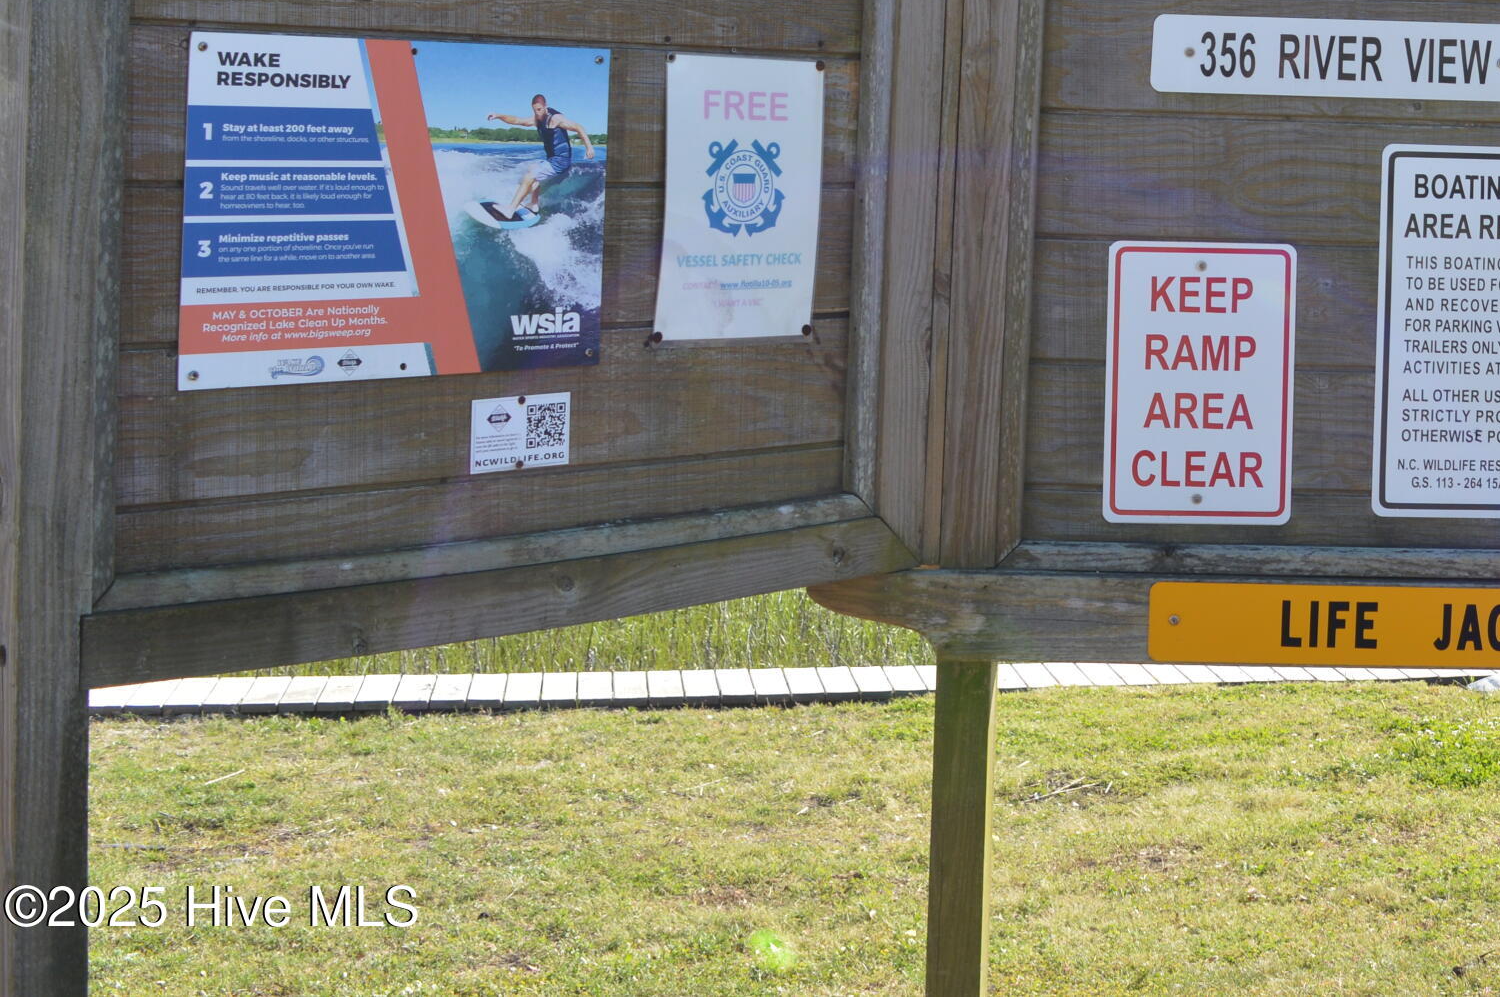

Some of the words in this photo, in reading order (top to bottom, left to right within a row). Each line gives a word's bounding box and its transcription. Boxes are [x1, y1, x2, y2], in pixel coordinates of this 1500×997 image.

[218, 52, 280, 67] WAKE
[1200, 32, 1255, 78] 356
[1279, 34, 1382, 81] RIVER
[1404, 38, 1492, 84] VIEW
[217, 71, 351, 89] RESPONSIBLY
[704, 90, 788, 121] FREE
[203, 123, 212, 140] 1
[223, 124, 246, 134] Stay
[247, 124, 258, 132] at
[259, 124, 284, 132] least
[307, 125, 326, 133] feet
[328, 127, 354, 135] away
[221, 173, 247, 182] Keep
[249, 172, 279, 180] music
[348, 172, 377, 180] levels.
[725, 155, 752, 170] COAST
[755, 159, 769, 193] GUARD
[200, 182, 213, 199] 2
[723, 201, 764, 218] AUXILIARY
[1404, 213, 1471, 239] AREA
[219, 234, 265, 243] Minimize
[267, 233, 315, 243] repetitive
[316, 234, 349, 243] passes
[198, 240, 211, 257] 3
[677, 255, 718, 267] VESSEL
[721, 254, 762, 266] SAFETY
[766, 254, 802, 265] CHECK
[1407, 256, 1437, 269] THIS
[1406, 277, 1423, 290] TO
[1428, 277, 1445, 290] BE
[1451, 278, 1485, 291] USED
[1151, 276, 1253, 313] KEEP
[1405, 298, 1434, 311] AND
[510, 307, 580, 335] wsia
[1405, 319, 1431, 332] FOR
[1436, 319, 1492, 333] PARKING
[1145, 334, 1256, 371] RAMP
[1404, 340, 1467, 353] TRAILERS
[1403, 360, 1480, 375] ACTIVITIES
[1144, 393, 1253, 429] AREA
[1132, 450, 1263, 488] CLEAR
[1281, 600, 1378, 649] LIFE
